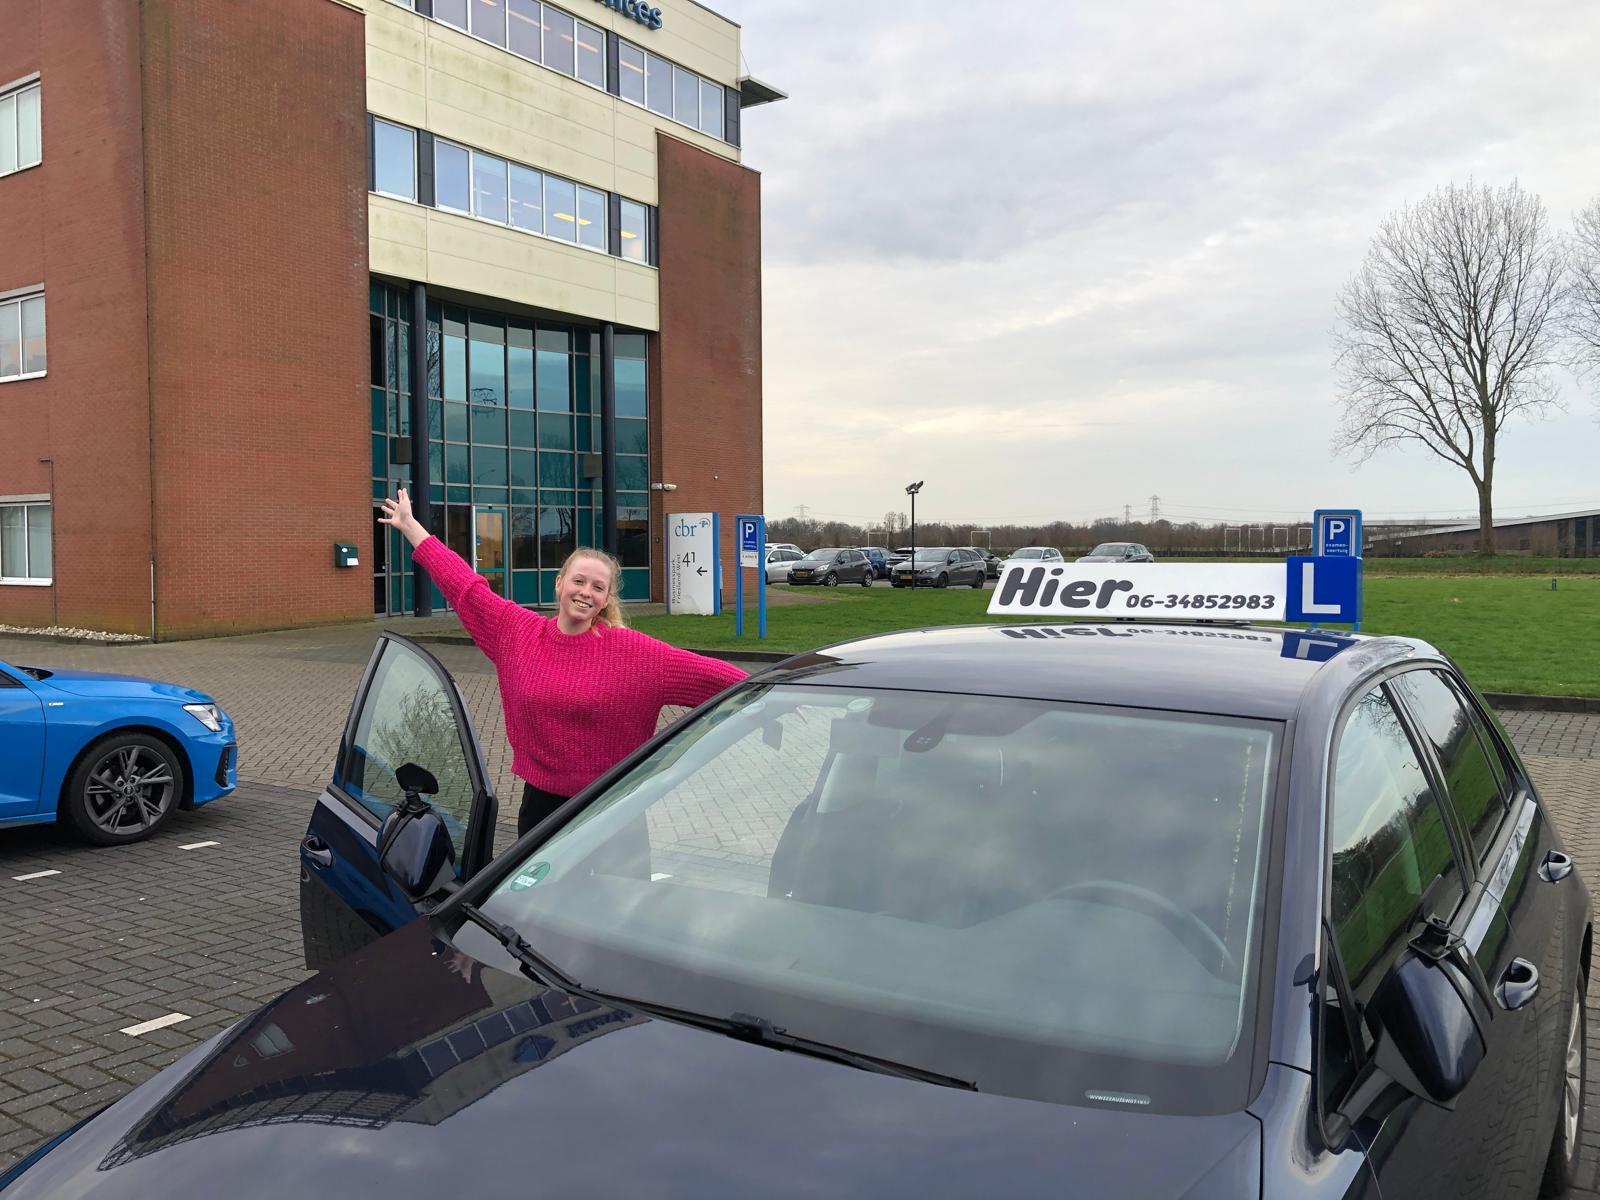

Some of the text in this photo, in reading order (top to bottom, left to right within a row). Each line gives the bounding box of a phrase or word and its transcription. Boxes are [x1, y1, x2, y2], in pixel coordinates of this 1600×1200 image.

[674, 519, 697, 537] cbr
[745, 523, 754, 538] P
[1330, 520, 1345, 540] P
[682, 552, 696, 567] 41
[998, 566, 1275, 610] Hier 06-34852983
[1302, 562, 1341, 614] L
